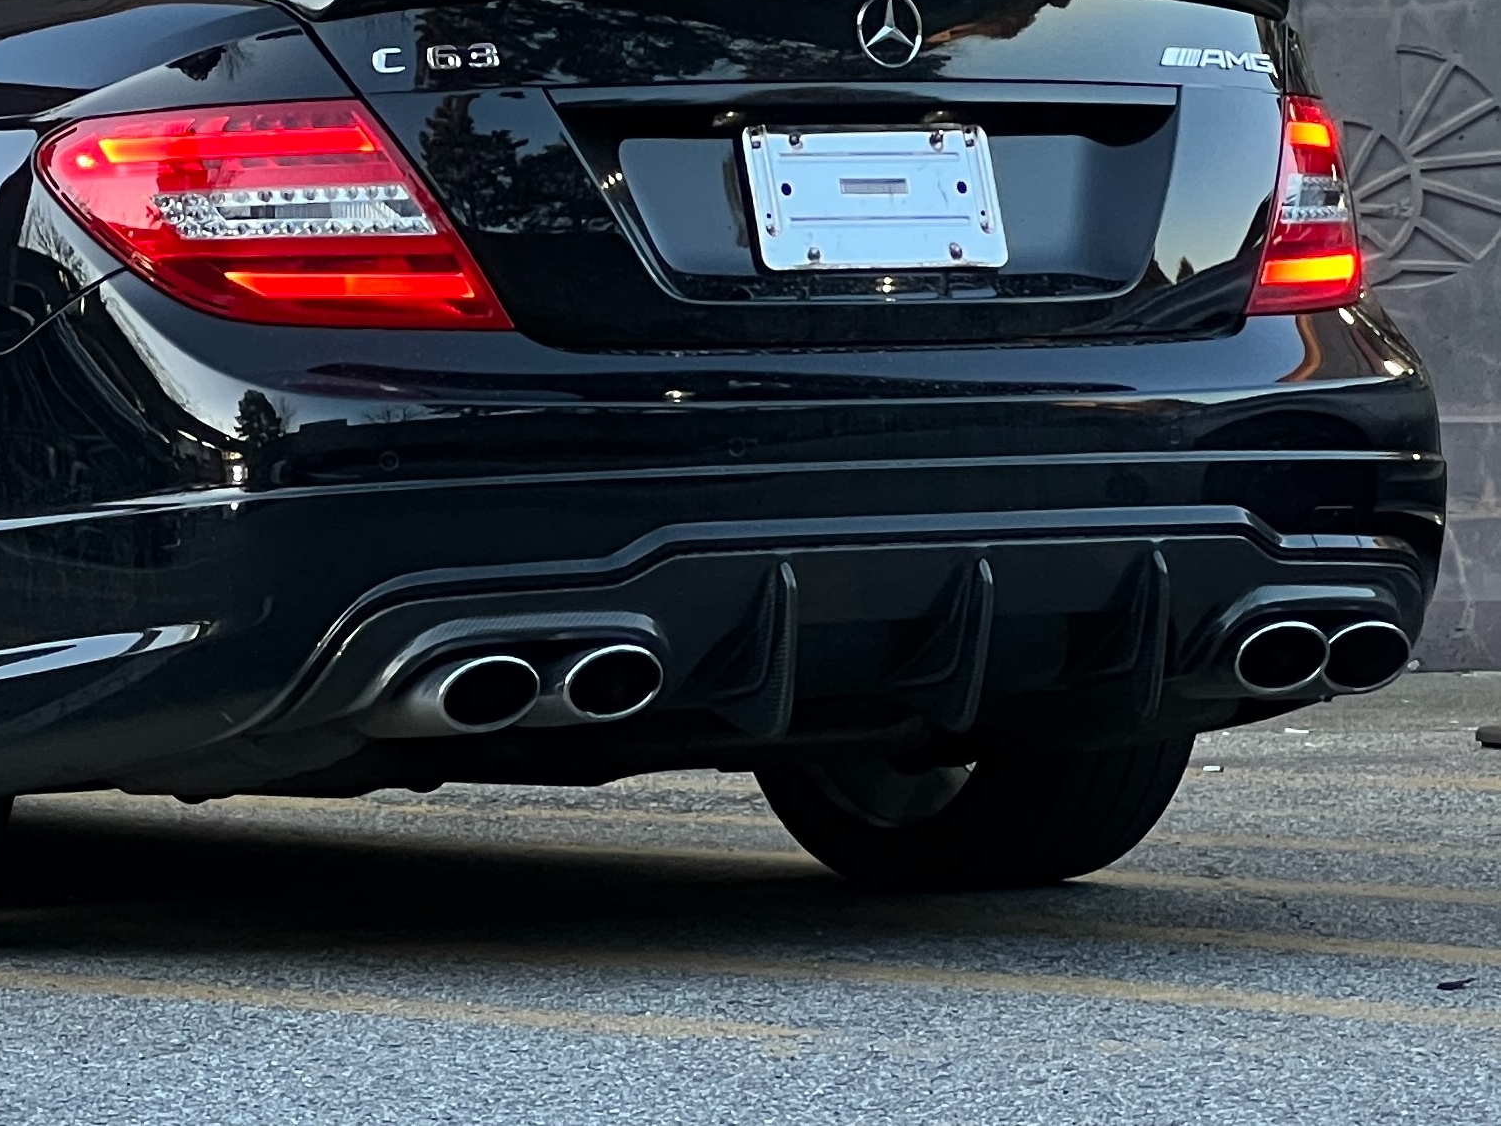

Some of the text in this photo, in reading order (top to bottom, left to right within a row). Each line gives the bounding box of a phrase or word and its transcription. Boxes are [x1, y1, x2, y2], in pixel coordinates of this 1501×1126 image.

[372, 42, 500, 73] C 63
[1199, 48, 1274, 74] AMG
